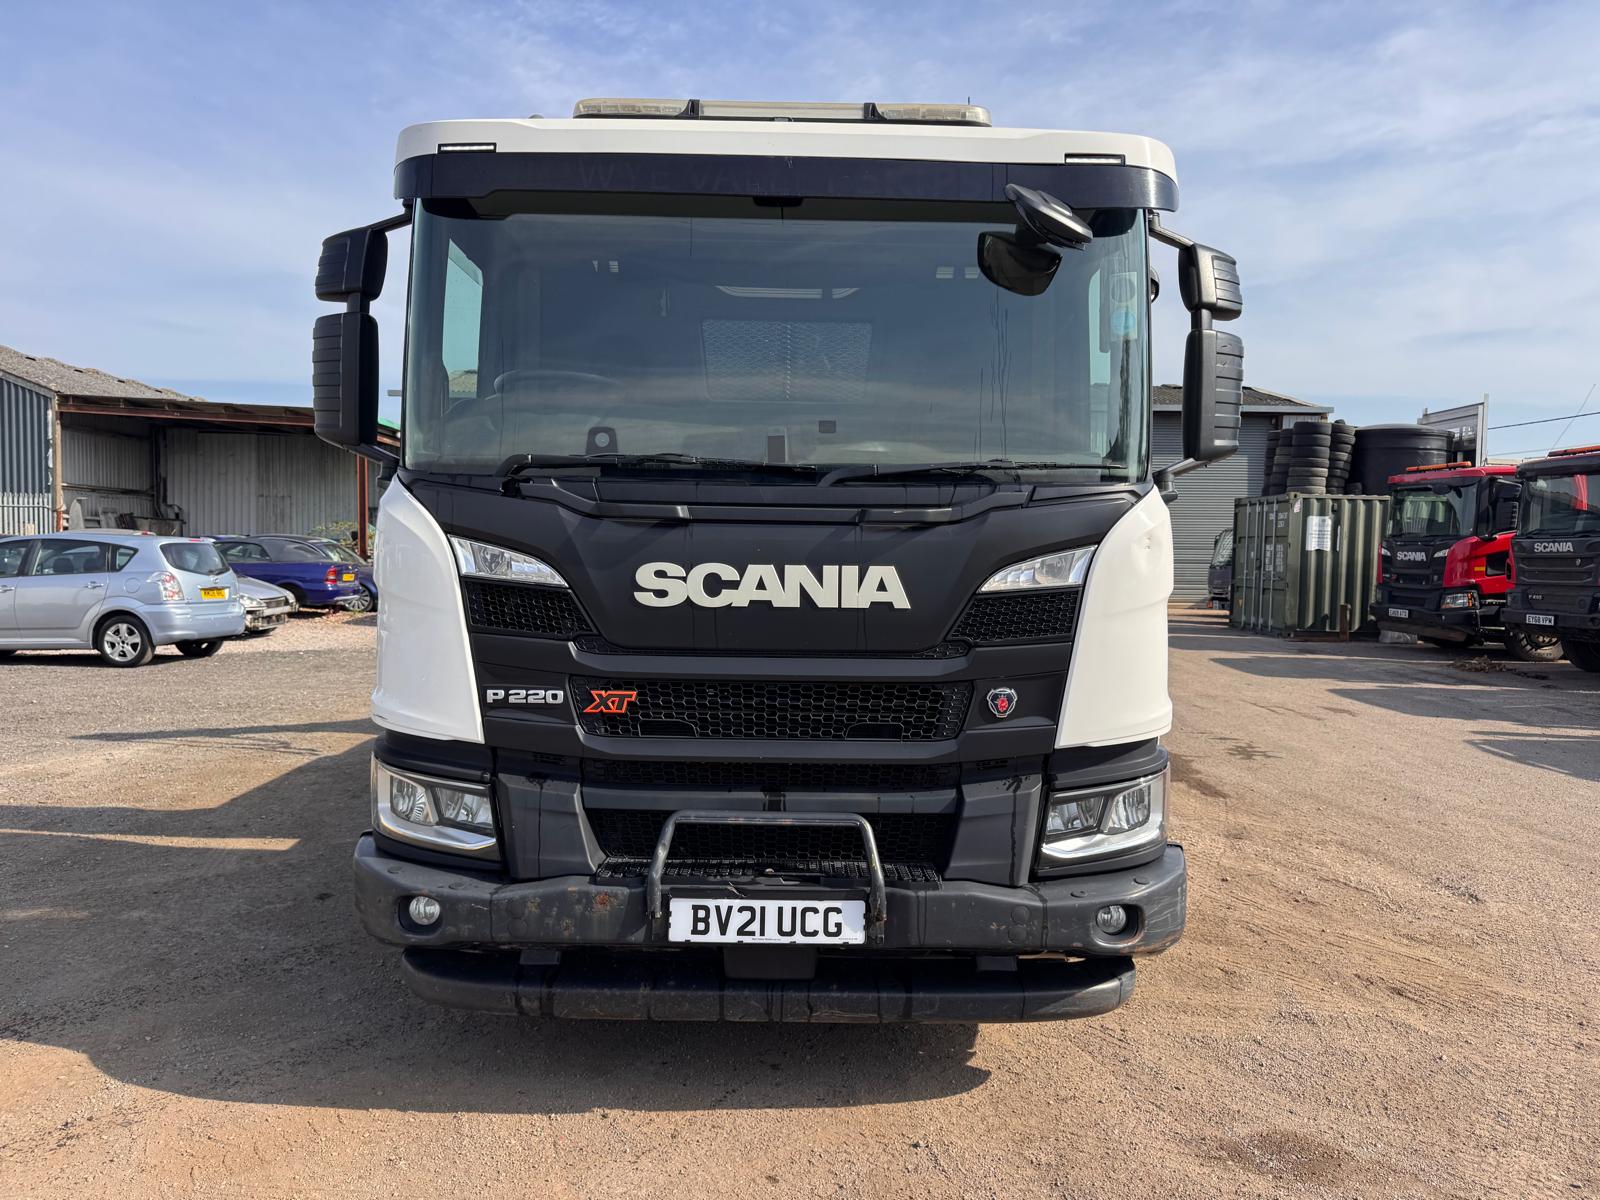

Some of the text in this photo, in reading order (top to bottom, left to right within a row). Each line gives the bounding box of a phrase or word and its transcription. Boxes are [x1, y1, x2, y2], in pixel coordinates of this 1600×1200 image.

[1397, 551, 1427, 562] SCANIA
[1534, 542, 1574, 552] SCANIA
[633, 561, 911, 609] SCANIA
[486, 689, 564, 704] P 220
[583, 690, 637, 713] XT
[690, 904, 843, 938] BV21 UCG
